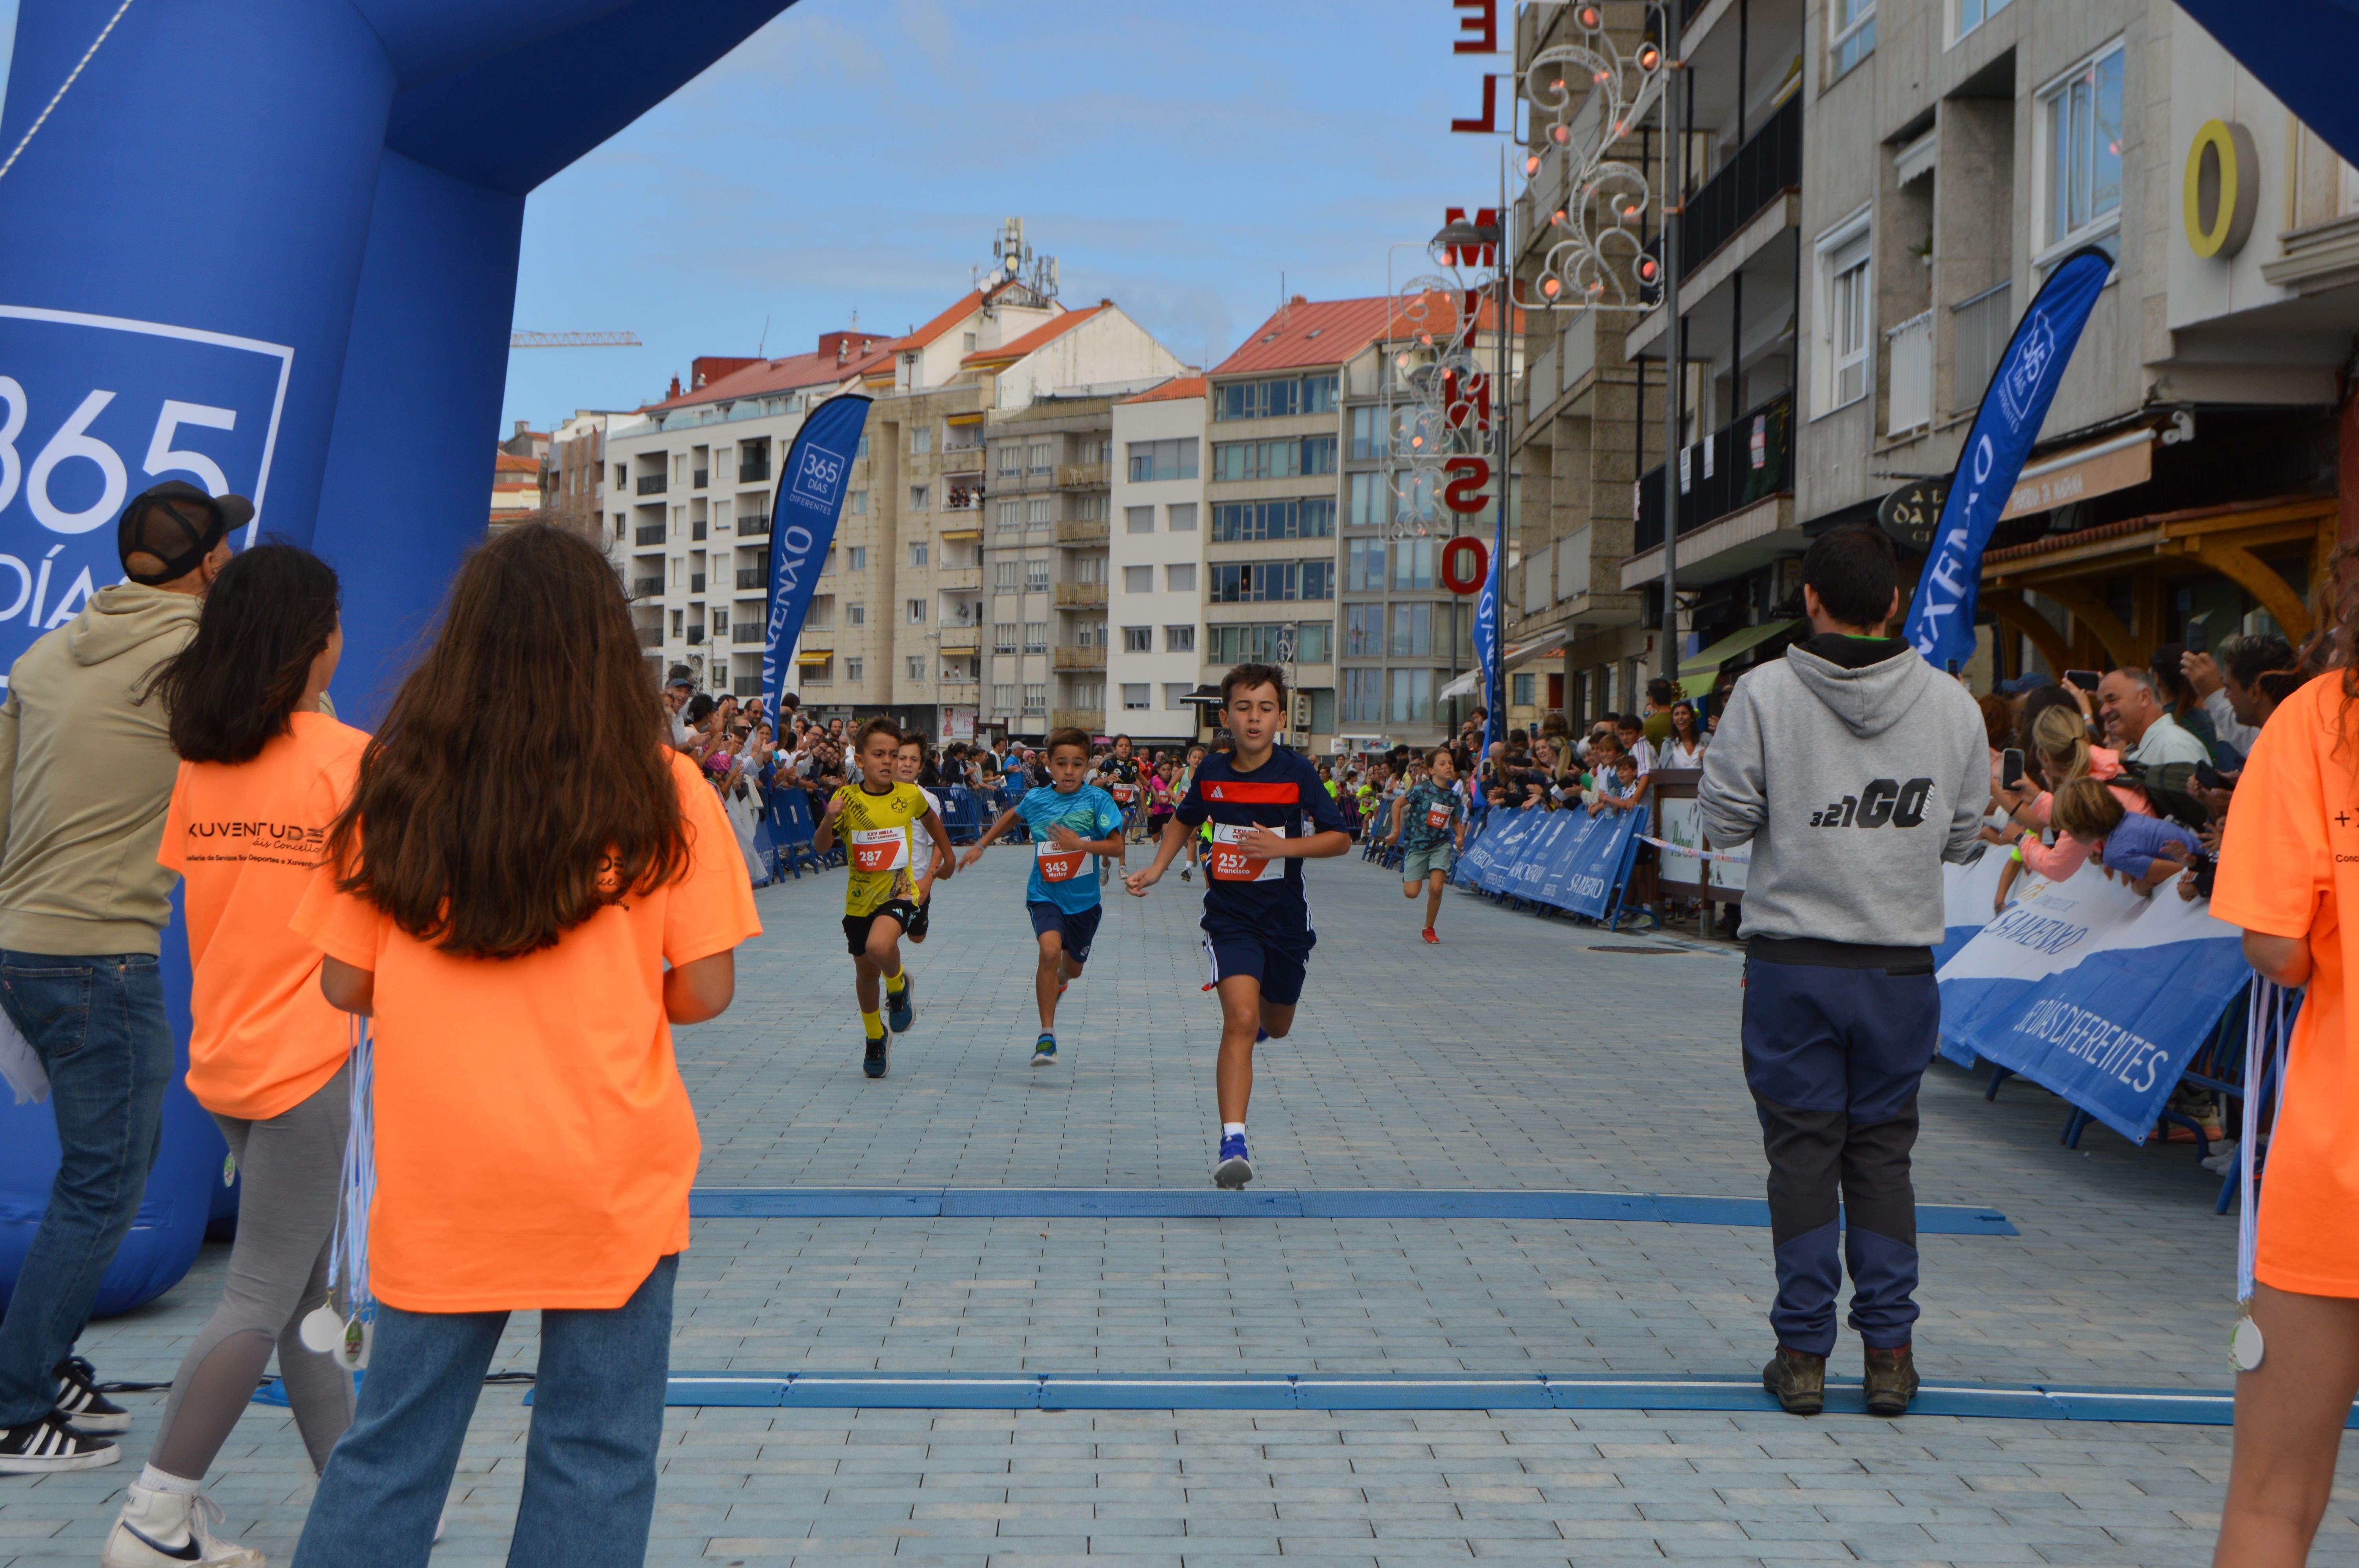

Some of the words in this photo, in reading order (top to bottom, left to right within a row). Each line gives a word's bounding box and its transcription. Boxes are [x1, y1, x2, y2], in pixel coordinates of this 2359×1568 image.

[804, 454, 838, 483] 365
[807, 478, 828, 494] DÍAS
[789, 494, 832, 516] DIFERENTES
[0, 544, 131, 630] DÍA
[1431, 815, 1444, 823] 344
[249, 854, 279, 864] Deportes
[859, 850, 882, 862] 287
[1218, 853, 1248, 868] 257
[1045, 861, 1068, 873] 343
[1218, 866, 1250, 874] Francisco
[2048, 1006, 2169, 1093] DIFERENTES
